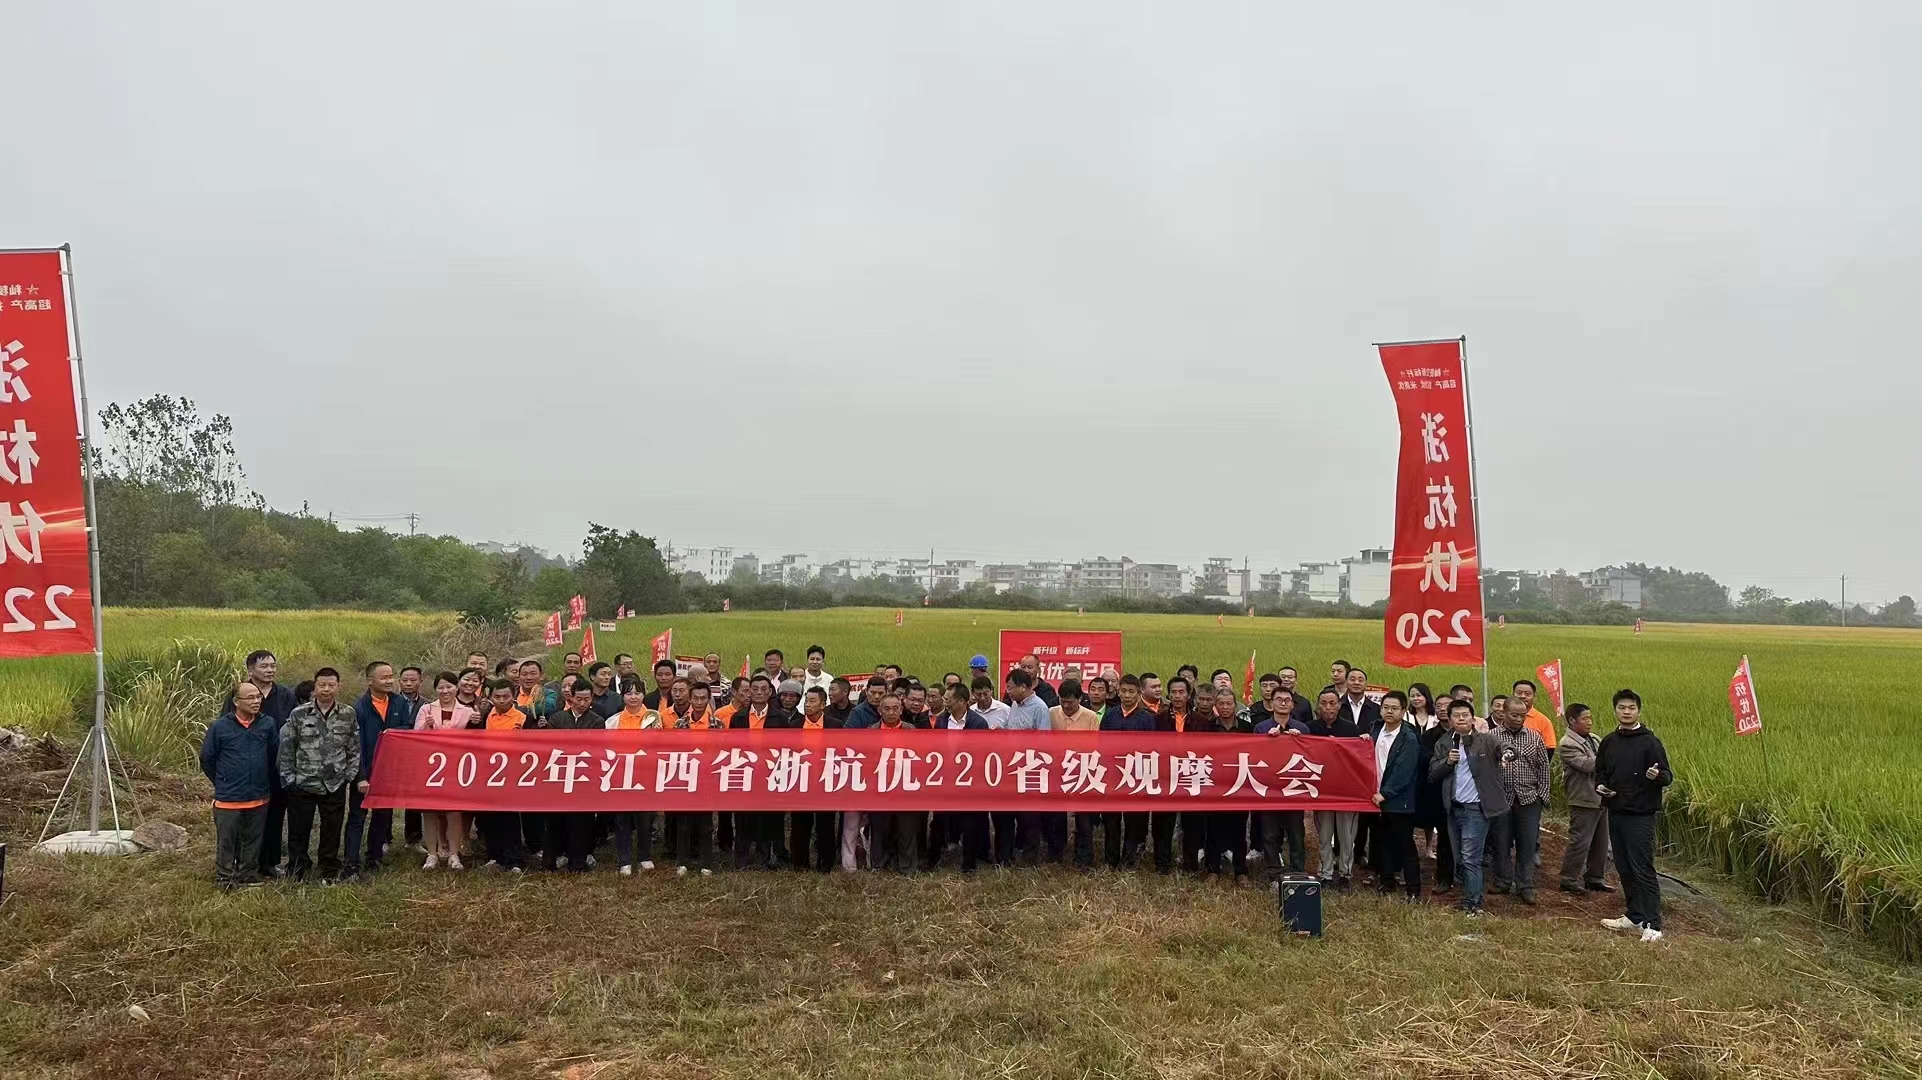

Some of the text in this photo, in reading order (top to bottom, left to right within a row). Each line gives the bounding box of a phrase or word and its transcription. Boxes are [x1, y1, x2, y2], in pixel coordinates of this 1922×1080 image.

[425, 747, 1325, 799] 2022年江西省浙杭优220省级观摩大会
